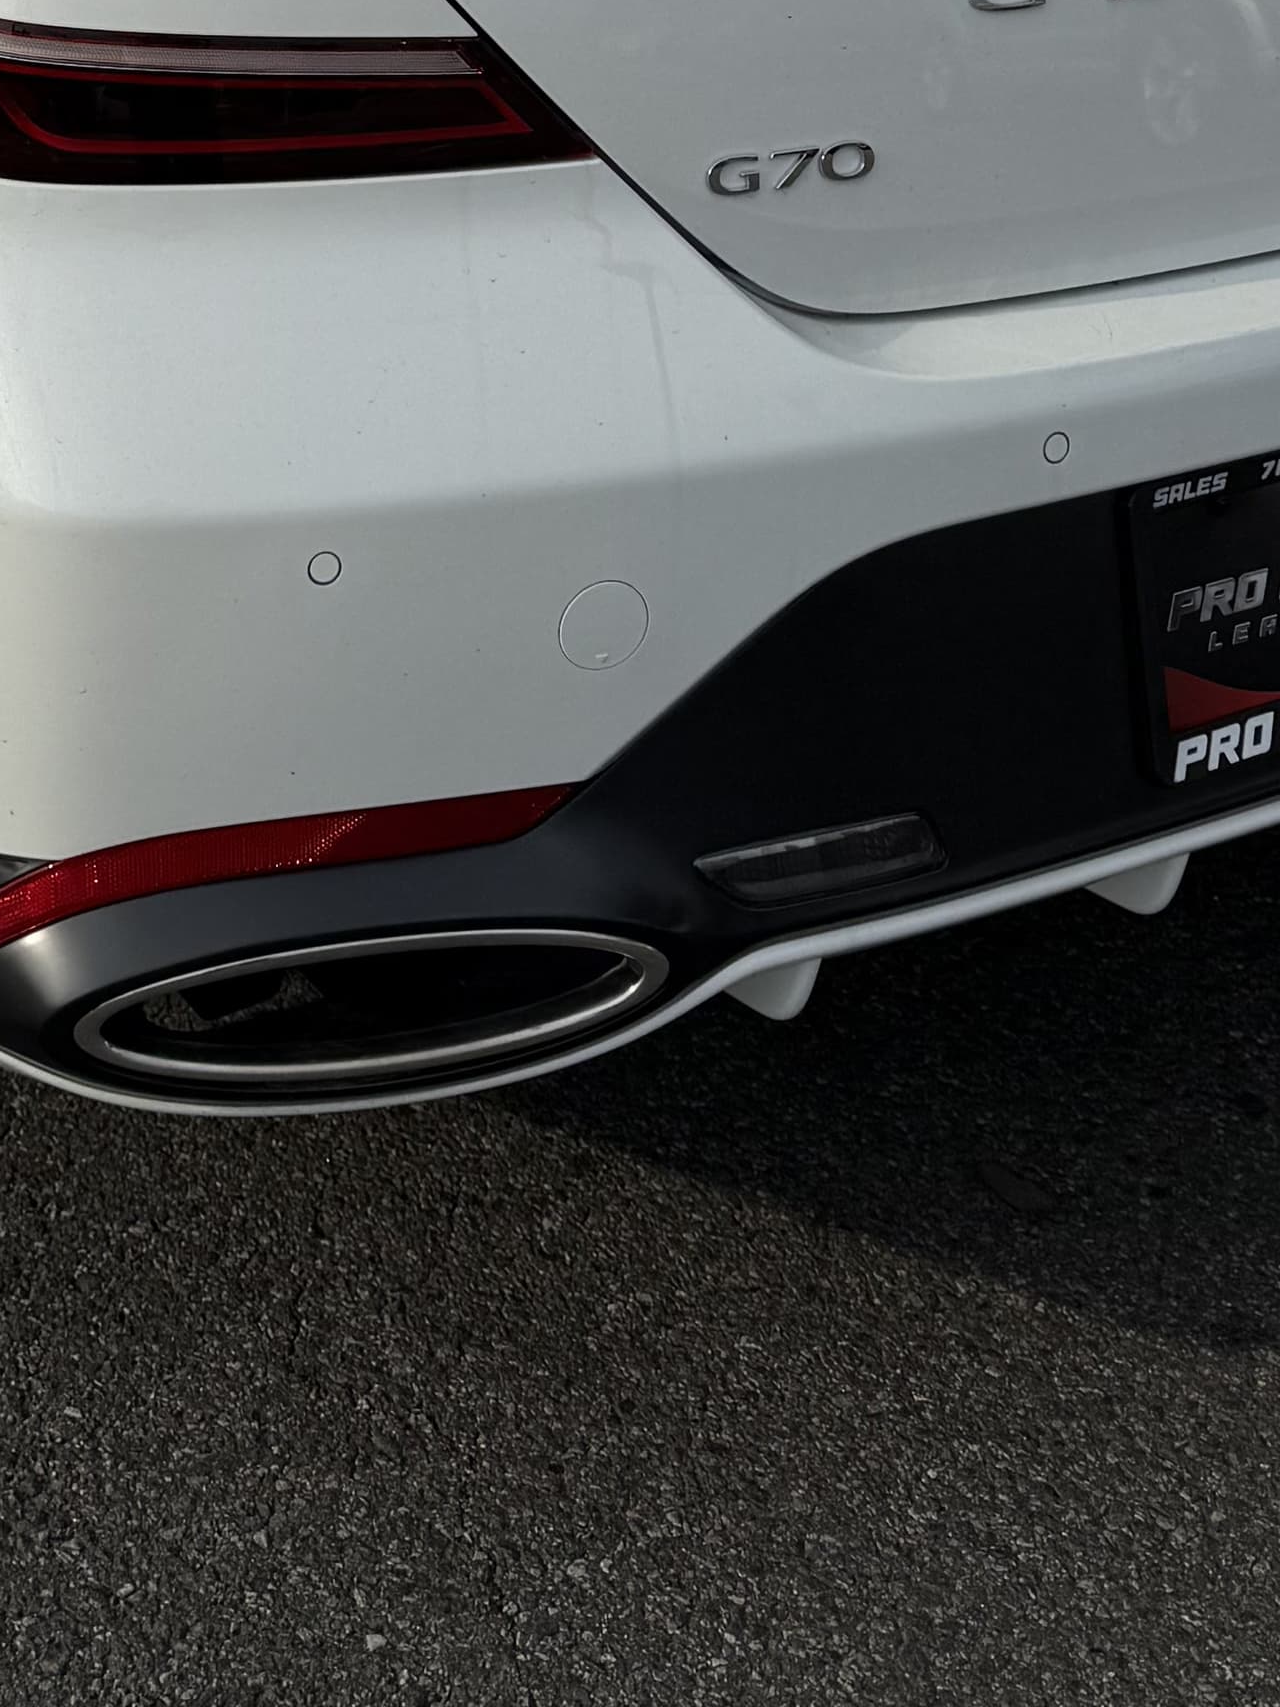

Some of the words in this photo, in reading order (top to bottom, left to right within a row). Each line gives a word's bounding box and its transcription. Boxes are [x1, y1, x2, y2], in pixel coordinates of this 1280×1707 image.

[705, 138, 877, 198] G70
[1152, 471, 1229, 509] SALES
[1166, 566, 1270, 634] PRO
[1173, 710, 1275, 784] PRO
